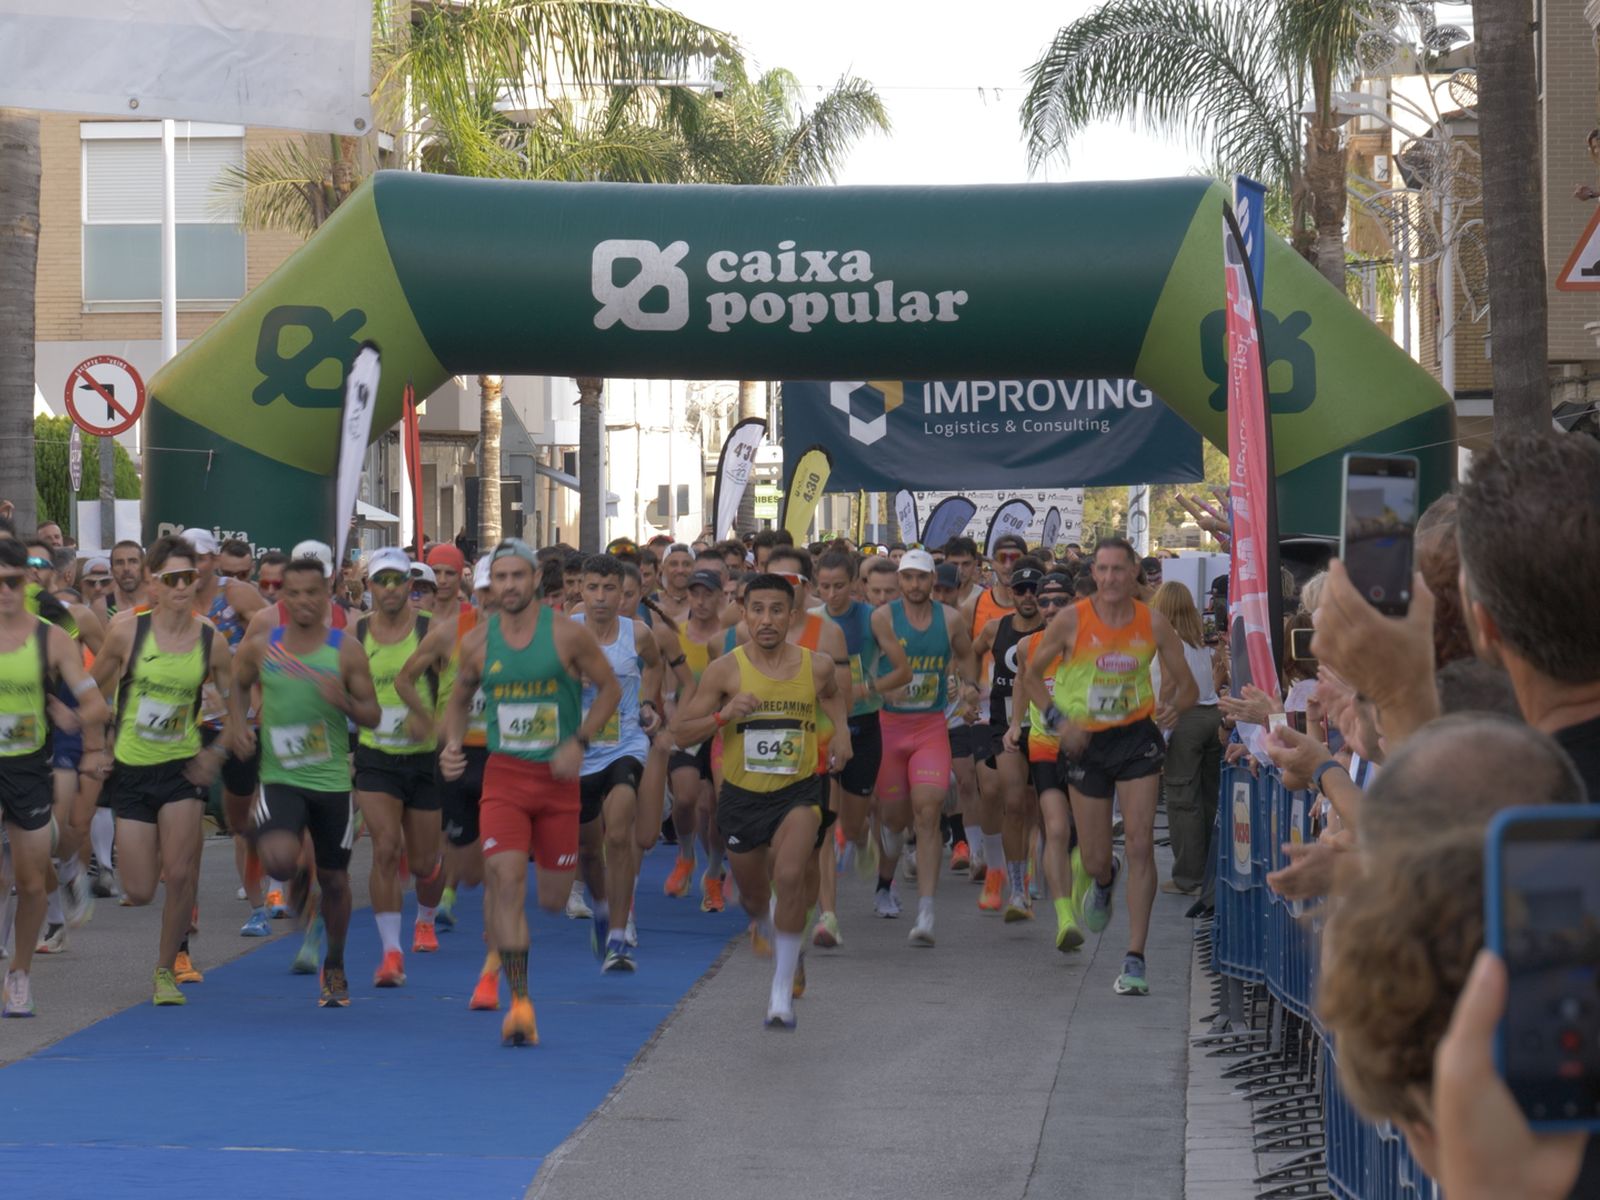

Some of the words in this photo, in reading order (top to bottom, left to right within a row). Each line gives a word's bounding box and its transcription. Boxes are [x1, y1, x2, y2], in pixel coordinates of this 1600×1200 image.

[706, 240, 874, 283] caixa
[706, 280, 969, 333] popular
[923, 379, 1153, 414] IMPROVING
[924, 420, 999, 437] Logistics
[1005, 419, 1017, 432] &
[1023, 417, 1111, 433] Consulting
[213, 526, 249, 543] ixa
[757, 740, 793, 756] 643
